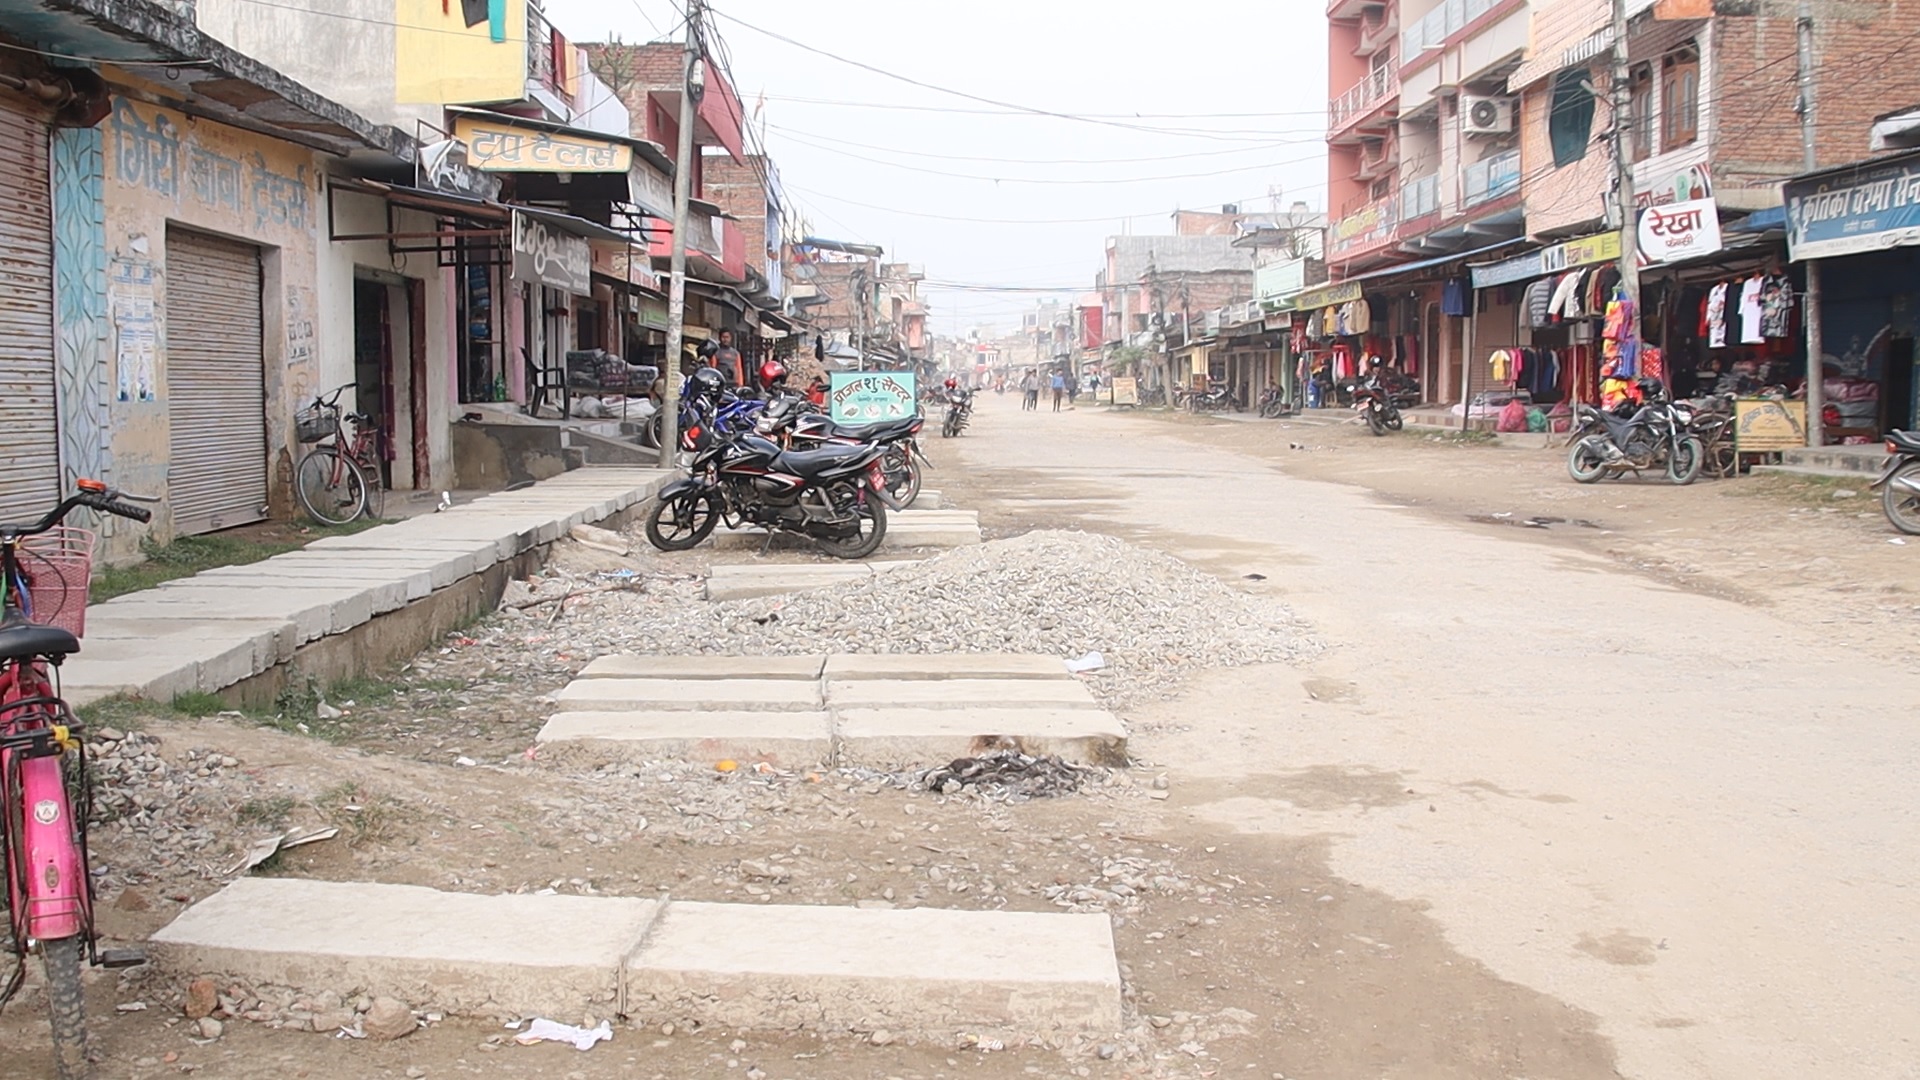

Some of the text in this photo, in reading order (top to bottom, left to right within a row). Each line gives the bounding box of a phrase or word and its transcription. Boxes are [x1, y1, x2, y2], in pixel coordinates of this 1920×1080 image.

[530, 132, 618, 168] टेलर्स
[1648, 209, 1702, 236] रेखा
[1801, 184, 1854, 232] कृतिका
[515, 211, 560, 275] Edge
